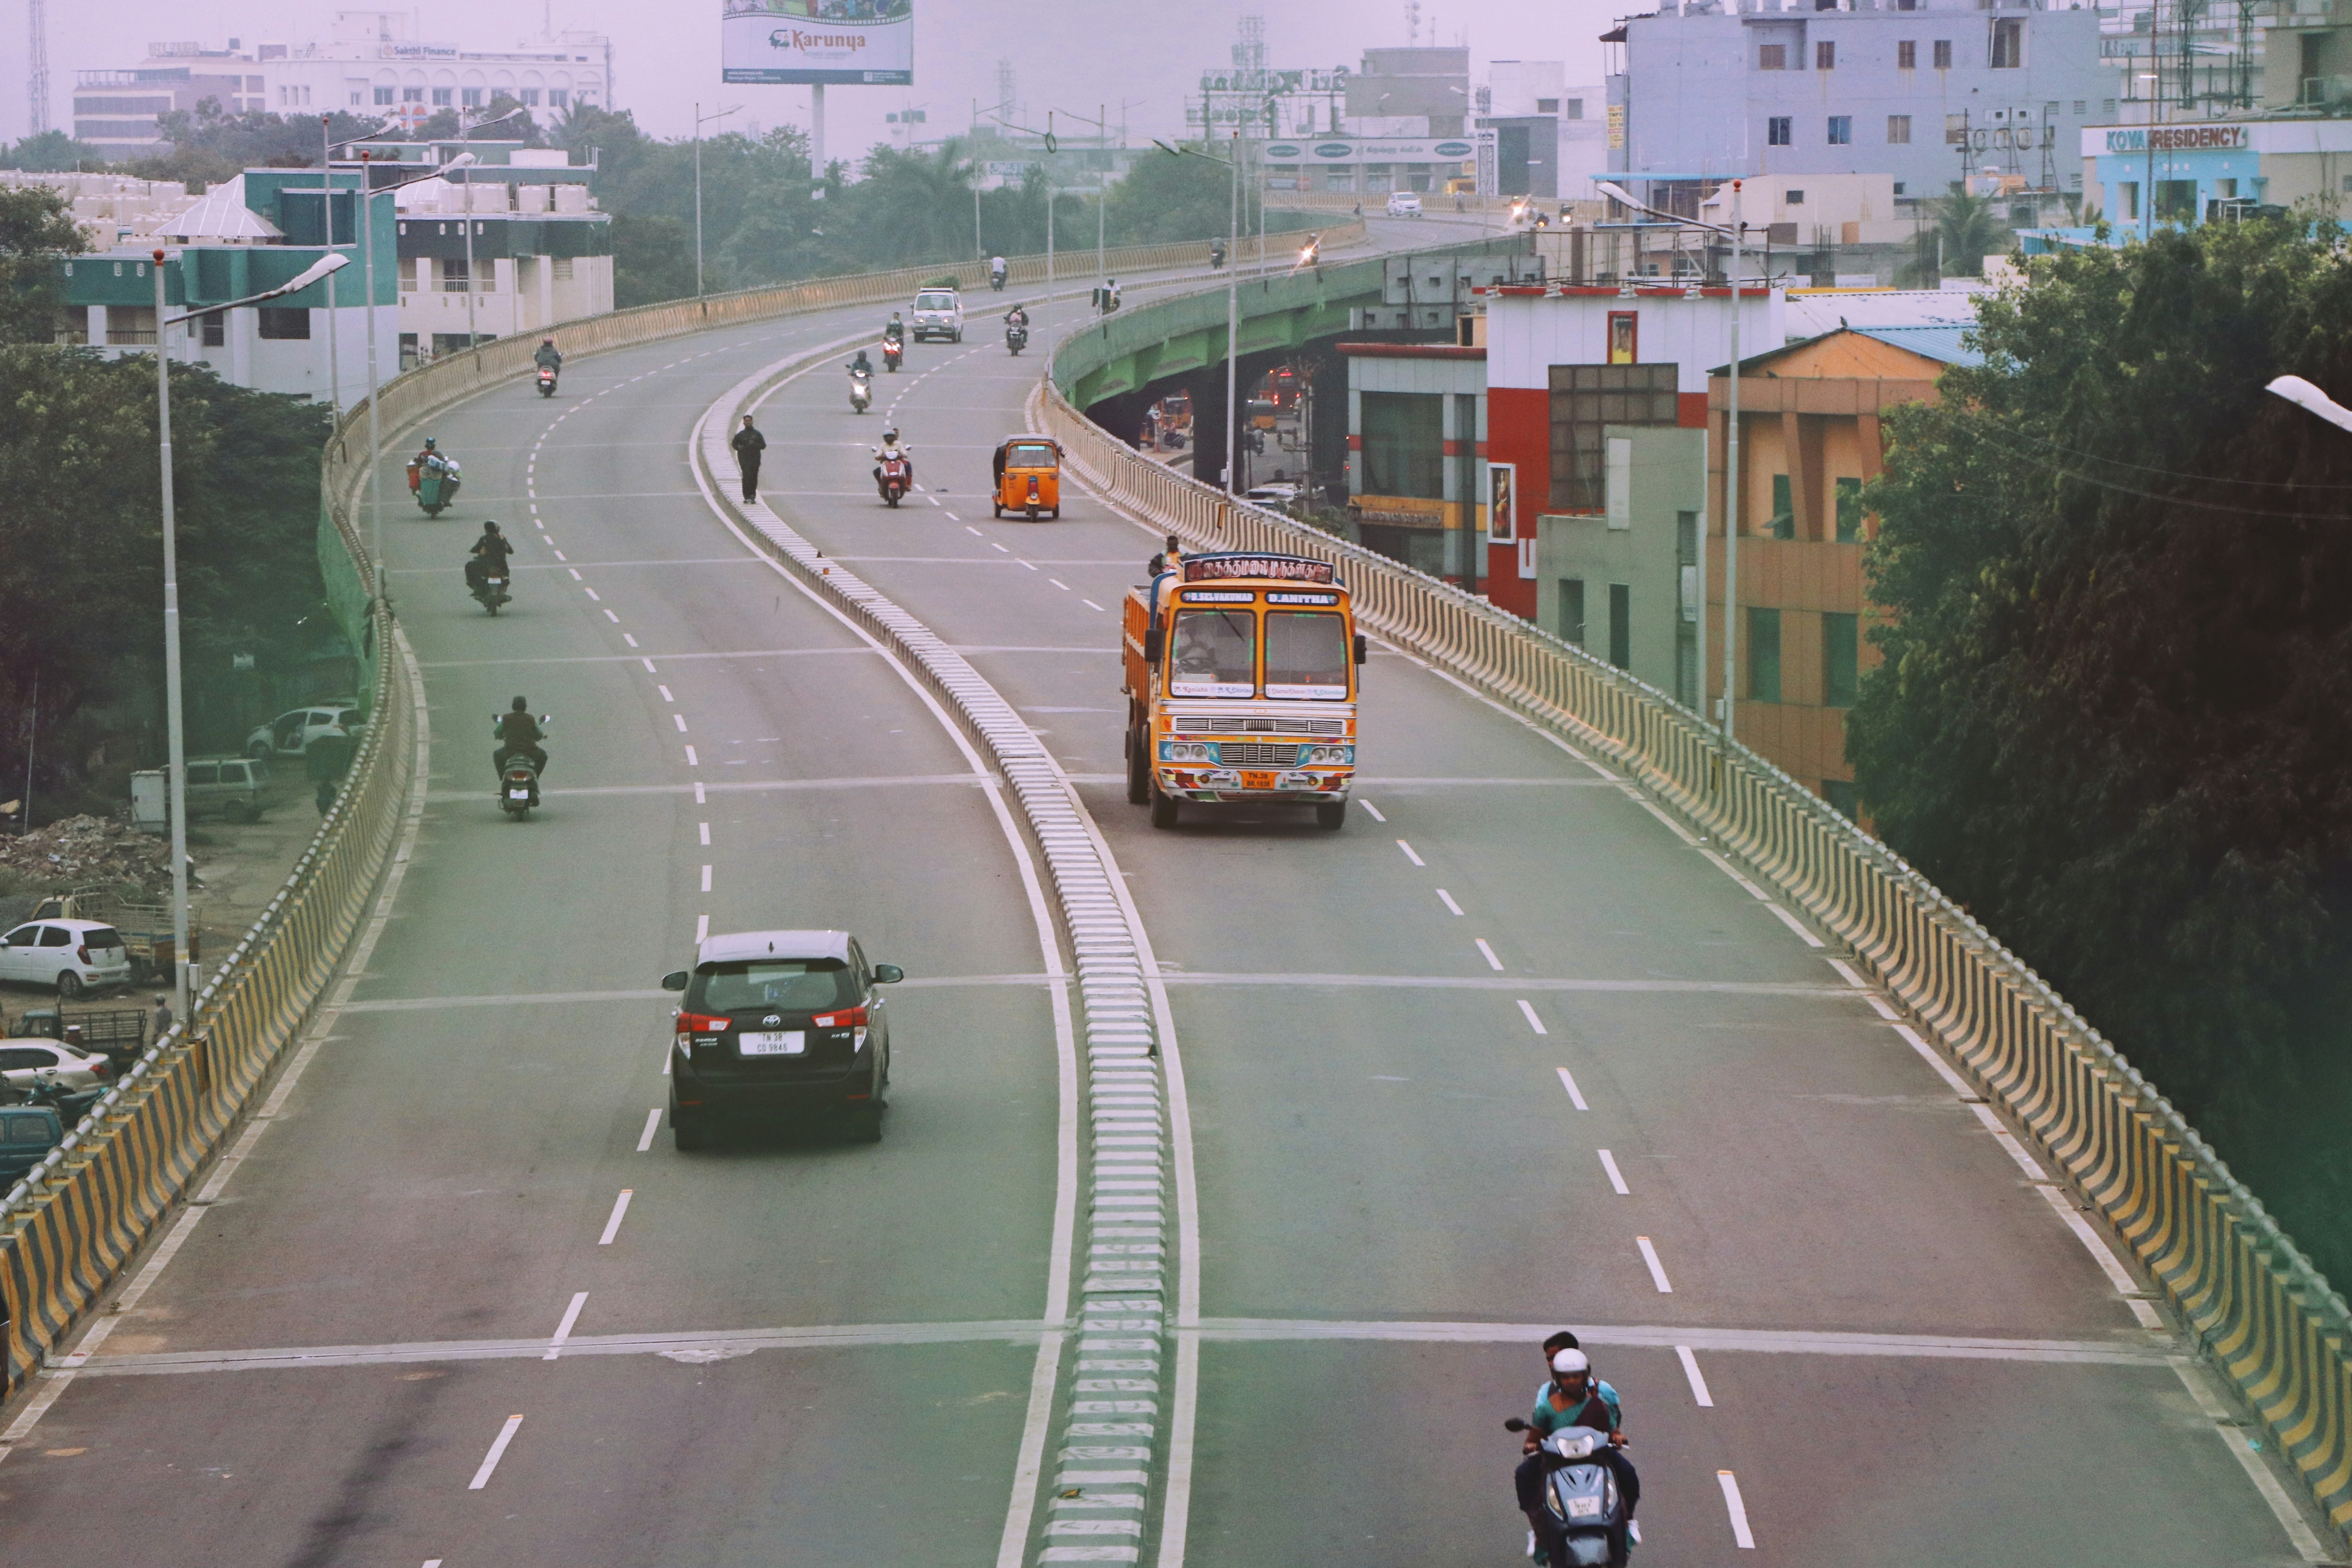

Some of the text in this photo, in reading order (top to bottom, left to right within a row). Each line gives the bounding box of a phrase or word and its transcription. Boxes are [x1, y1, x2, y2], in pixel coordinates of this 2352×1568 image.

[792, 30, 866, 52] Karunya
[394, 46, 456, 55] Sakthi Finance
[2152, 127, 2240, 149] RESIDENCY
[1191, 592, 1253, 601] D.SELVAKUMAR
[1268, 594, 1329, 603] D.ANITHA
[763, 1033, 771, 1041] TN
